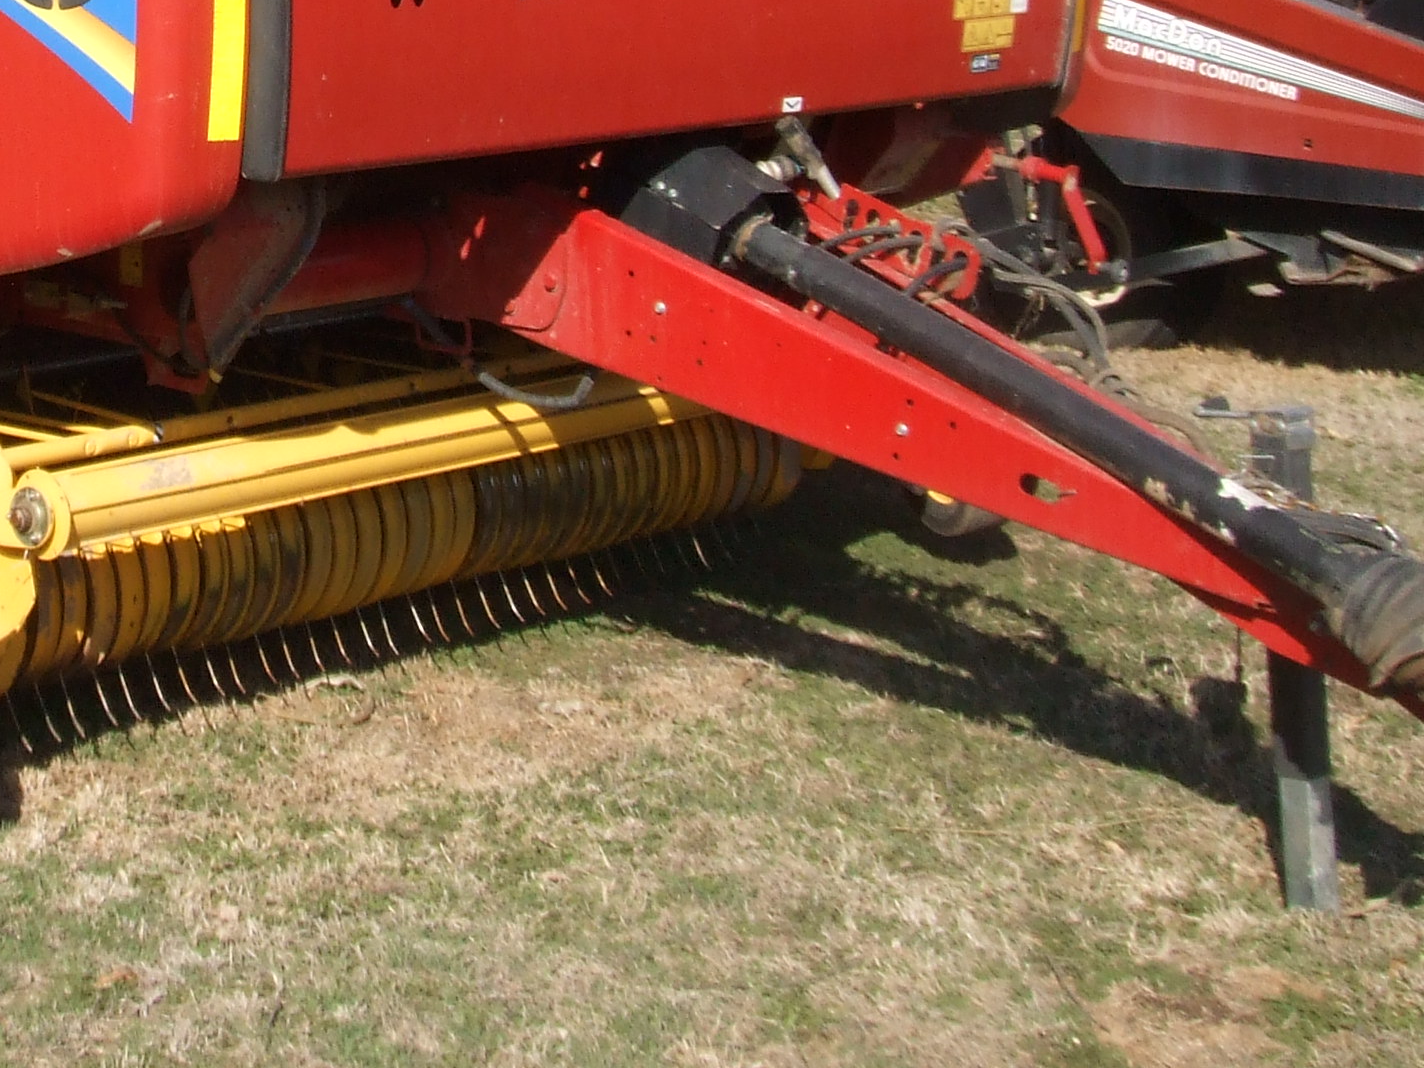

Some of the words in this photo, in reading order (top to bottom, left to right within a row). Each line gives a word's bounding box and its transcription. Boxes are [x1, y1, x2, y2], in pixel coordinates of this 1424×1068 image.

[1112, 3, 1224, 57] MacDon
[1105, 35, 1139, 56] 5020
[1141, 45, 1196, 73] MOWER
[1198, 61, 1299, 102] CONDITIONER
